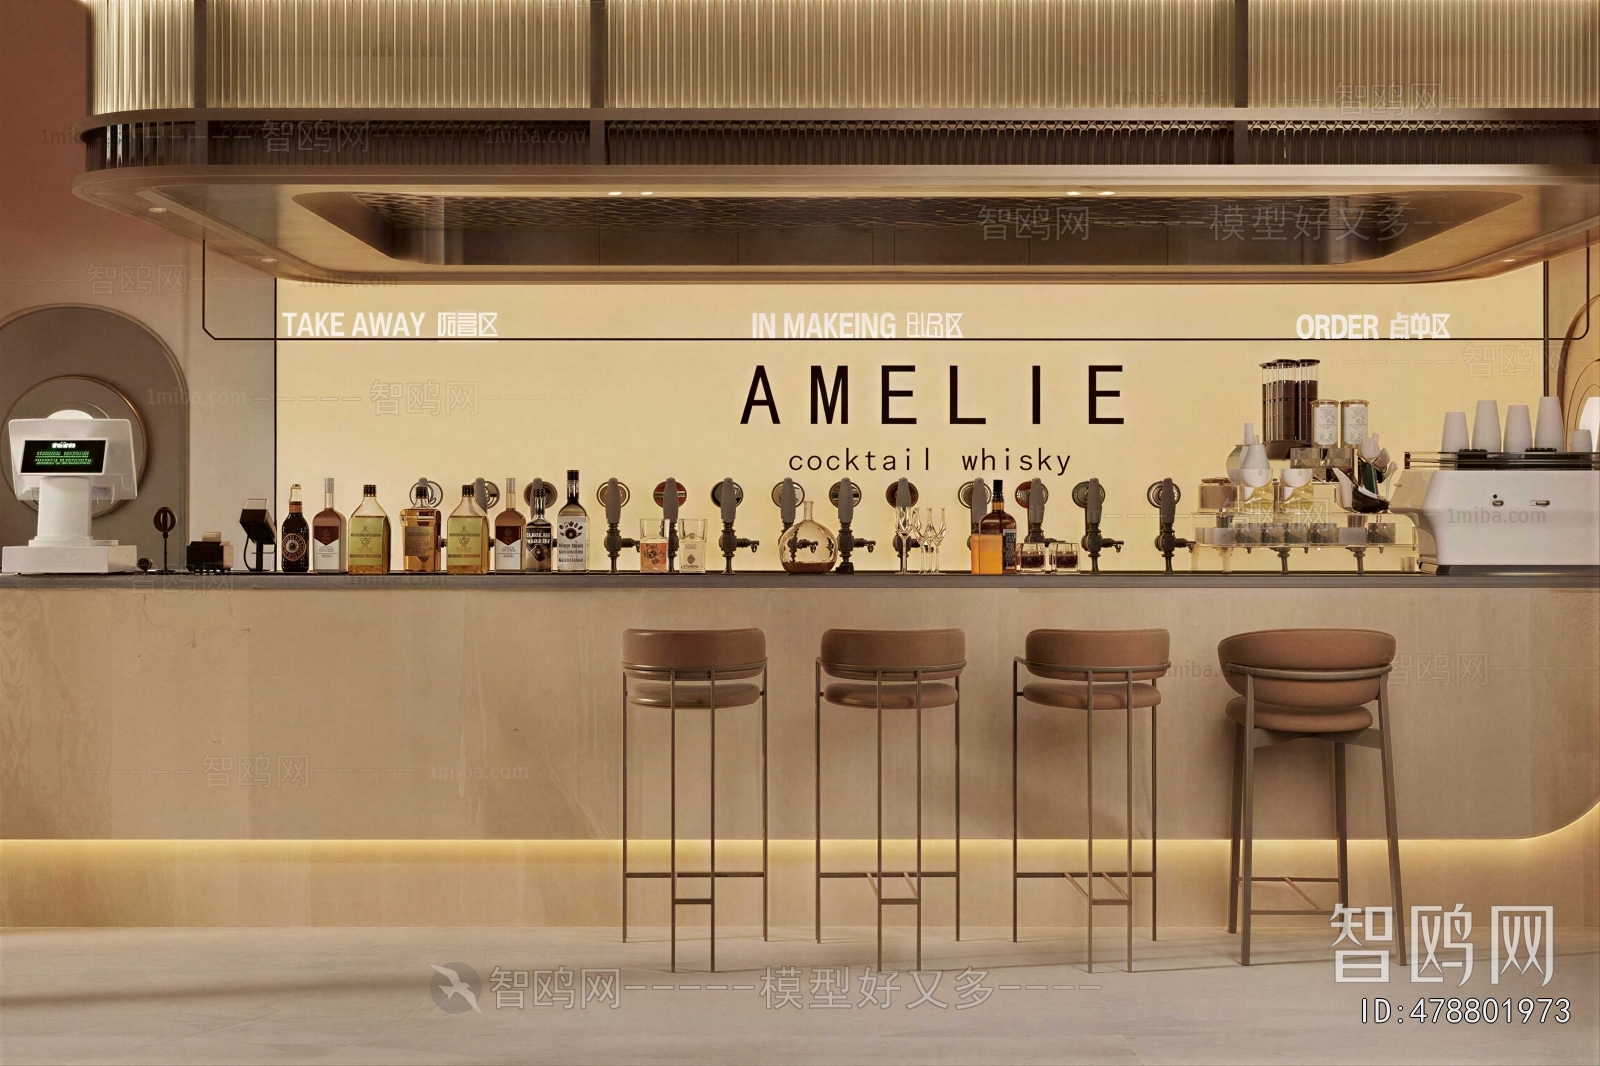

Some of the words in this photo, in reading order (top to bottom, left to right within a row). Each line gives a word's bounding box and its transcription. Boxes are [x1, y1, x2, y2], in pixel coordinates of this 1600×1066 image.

[281, 312, 345, 337] TAKE
[351, 312, 426, 337] AWAY
[751, 312, 776, 338] IN
[783, 312, 897, 339] MAKEING
[1296, 314, 1379, 339] ORDER
[740, 365, 1125, 425] AMELIE
[788, 447, 931, 471] cocktail
[961, 447, 1071, 477] whisky
